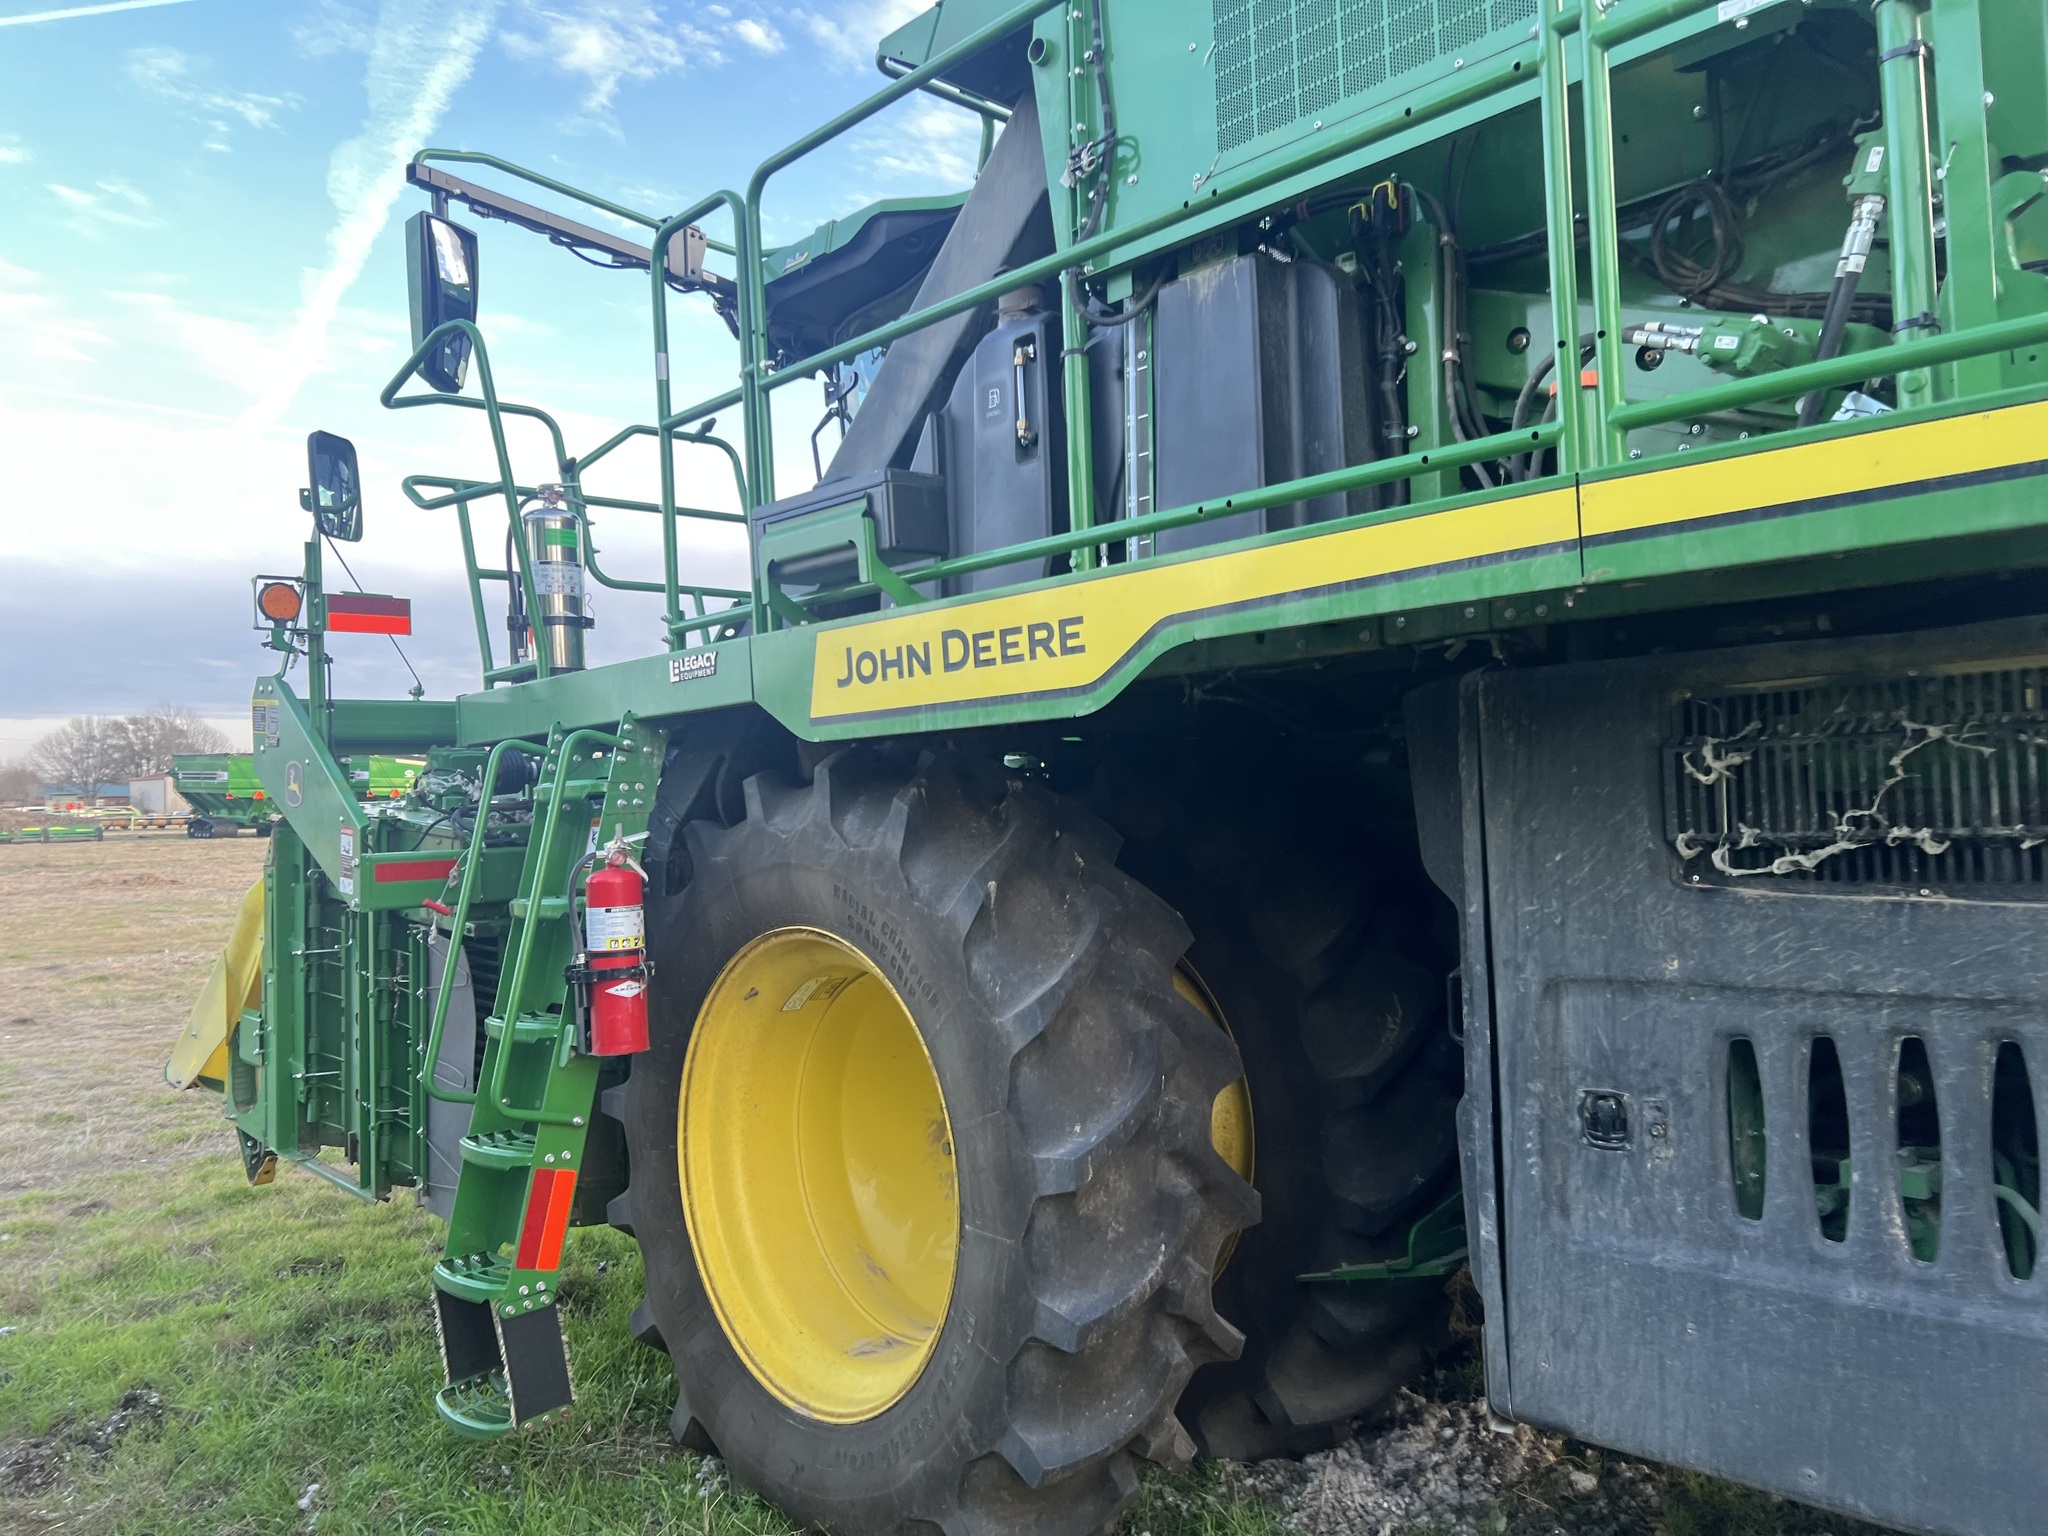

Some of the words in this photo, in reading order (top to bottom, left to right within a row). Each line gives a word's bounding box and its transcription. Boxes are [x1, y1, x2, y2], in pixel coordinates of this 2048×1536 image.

[680, 651, 717, 672] LEGACY
[837, 642, 932, 689] JOHN
[941, 615, 1087, 673] DEERE
[680, 667, 715, 681] EQUIPMENT
